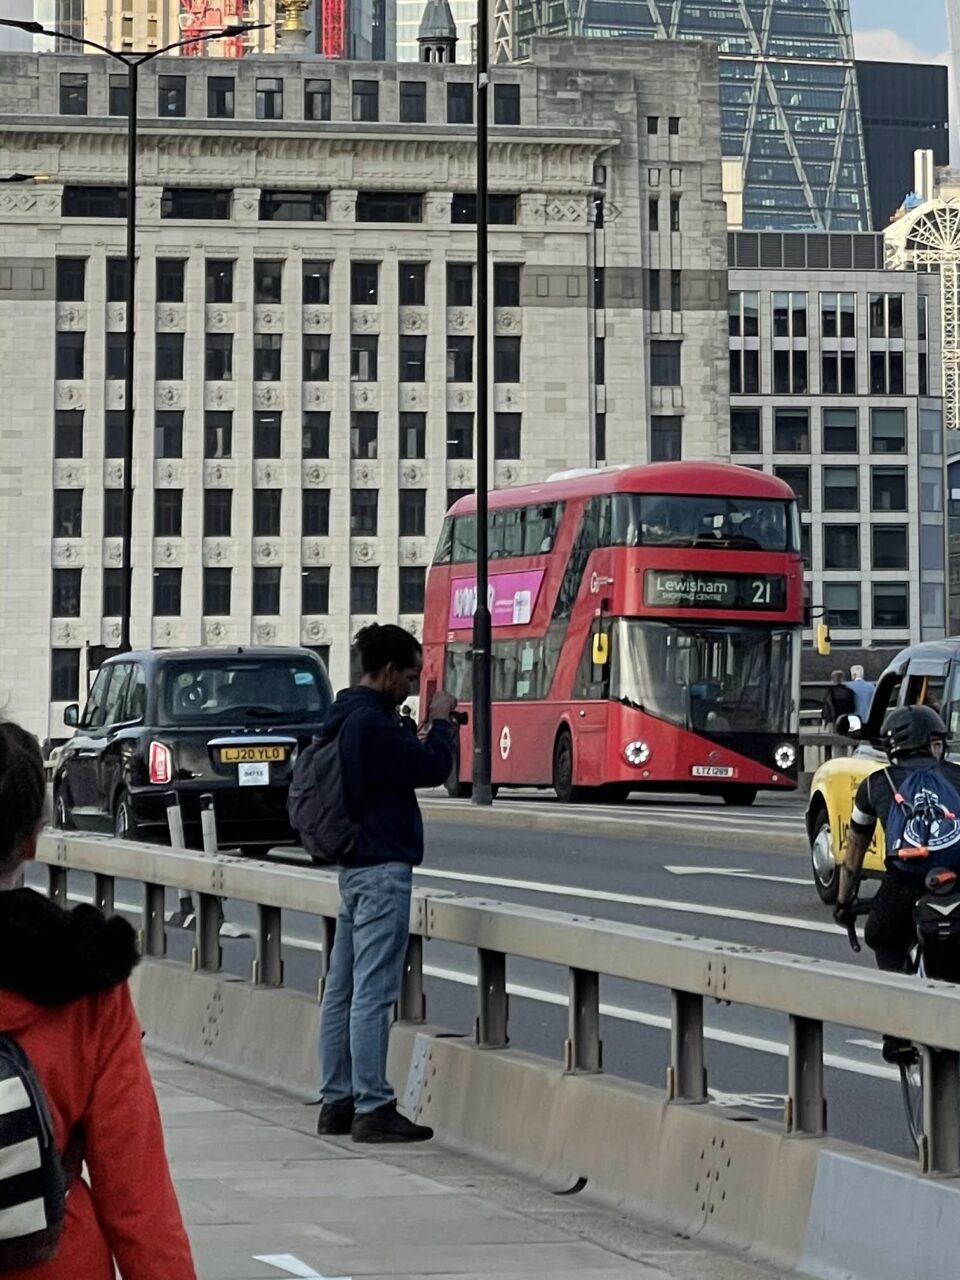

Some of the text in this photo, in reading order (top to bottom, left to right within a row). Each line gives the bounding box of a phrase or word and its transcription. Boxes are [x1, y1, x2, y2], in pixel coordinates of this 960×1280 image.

[656, 577, 728, 594] Lewisham
[751, 581, 771, 604] 21
[696, 593, 722, 602] CENTRE
[225, 749, 255, 761] LJ20
